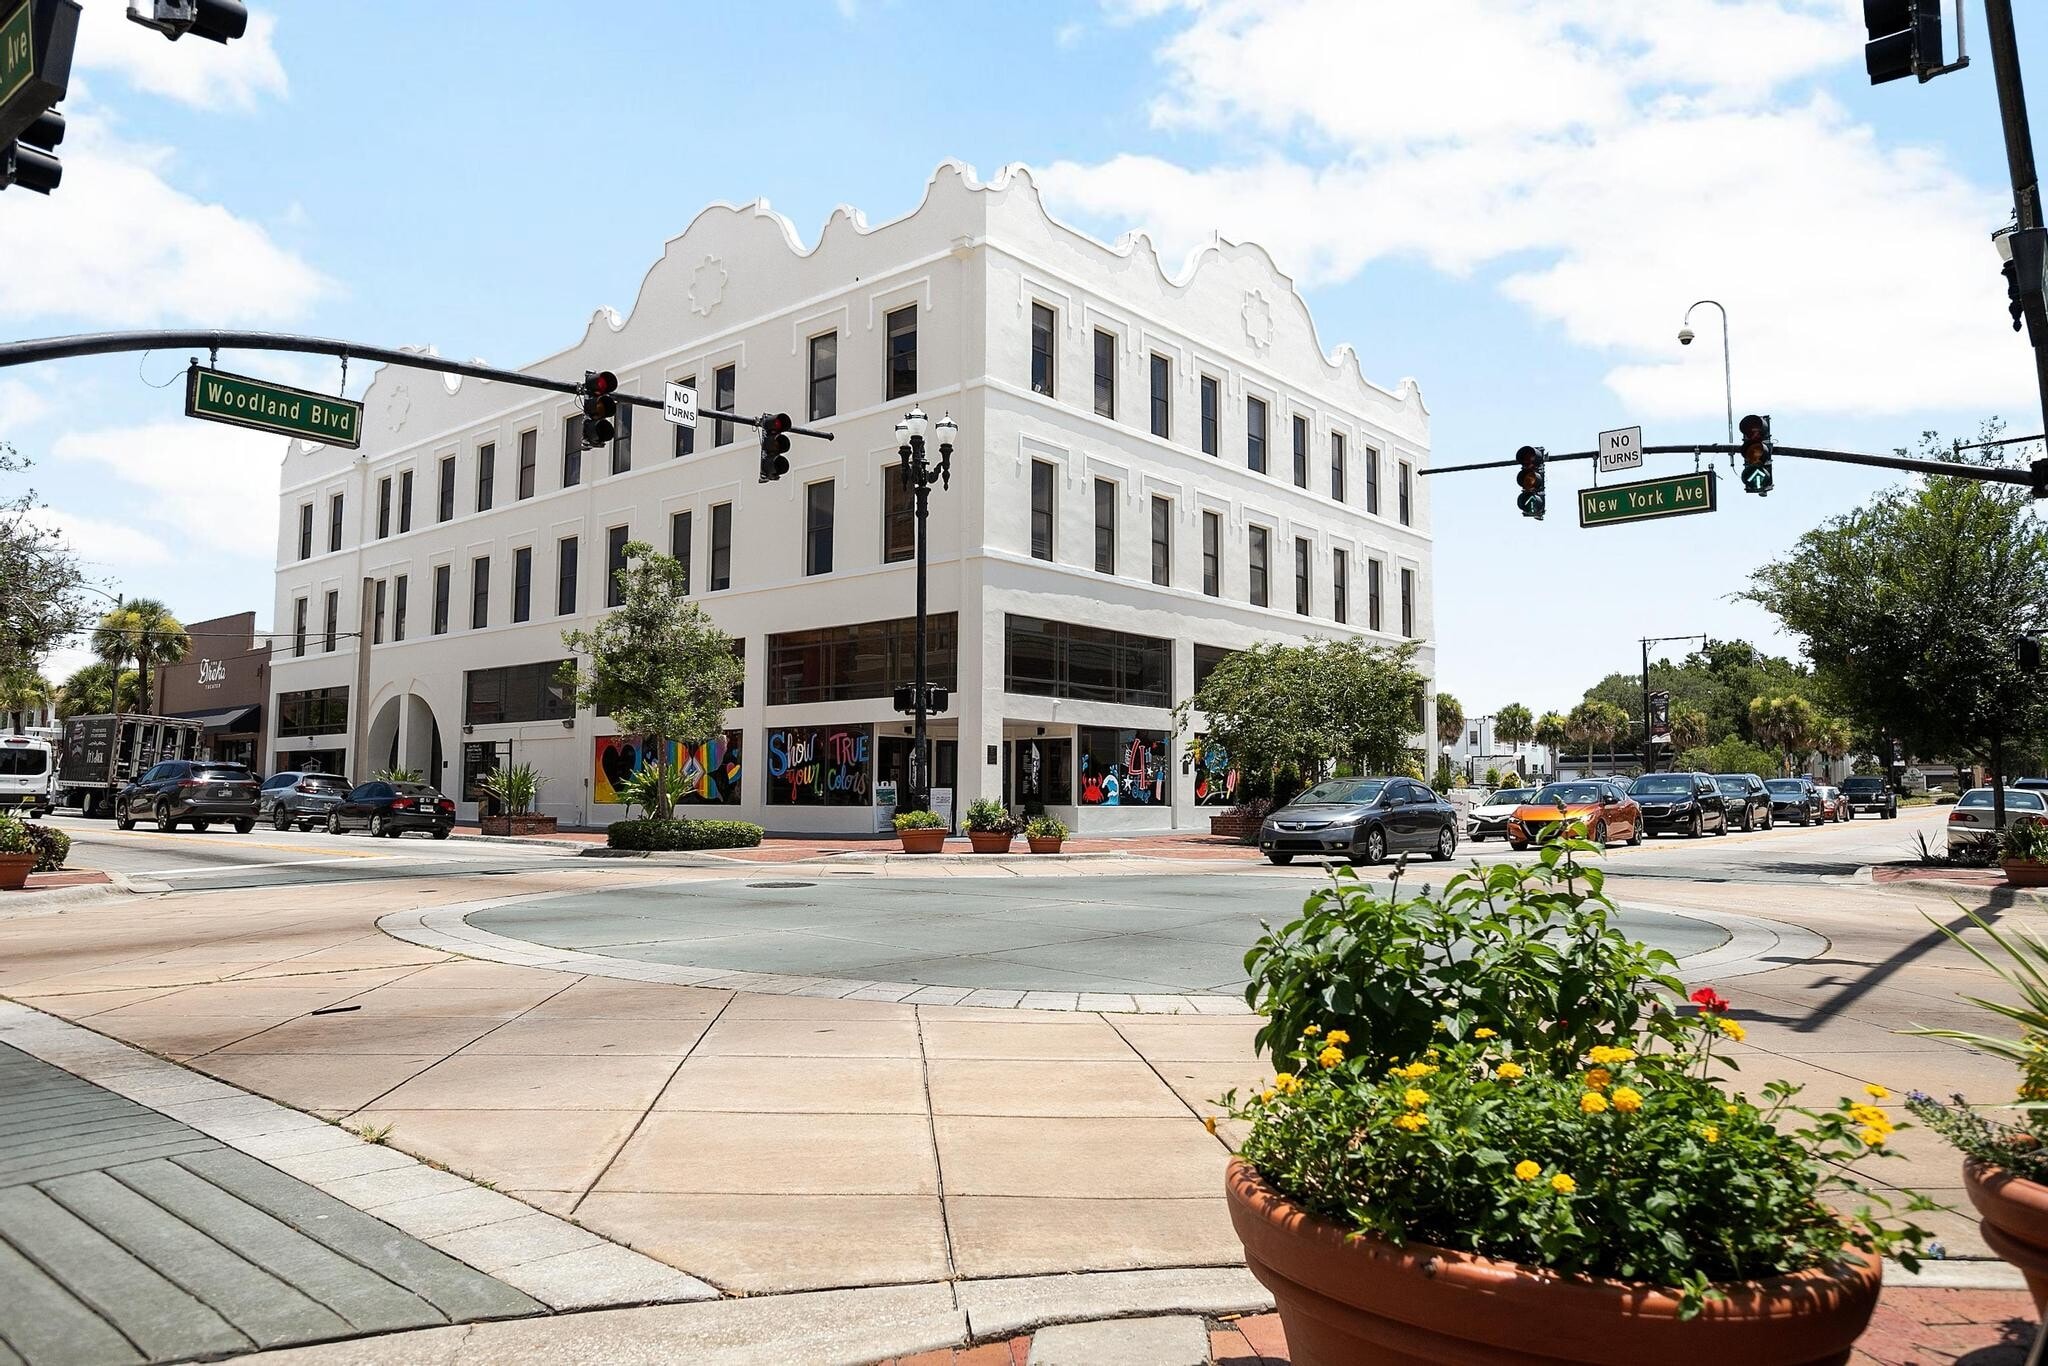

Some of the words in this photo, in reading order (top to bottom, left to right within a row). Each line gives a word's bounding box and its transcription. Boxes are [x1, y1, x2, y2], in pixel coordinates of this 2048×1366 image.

[8, 31, 27, 73] Ave
[208, 382, 300, 419] Woodland
[311, 405, 349, 430] Blvd
[674, 390, 689, 404] NO
[667, 405, 695, 421] TURNS
[1611, 435, 1630, 449] NO
[1603, 451, 1639, 465] TURNS
[1587, 498, 1618, 514] New
[1628, 489, 1664, 508] York
[1675, 486, 1703, 502] Ave
[769, 731, 817, 777] Show
[829, 732, 870, 766] TRUE
[786, 761, 824, 800] your
